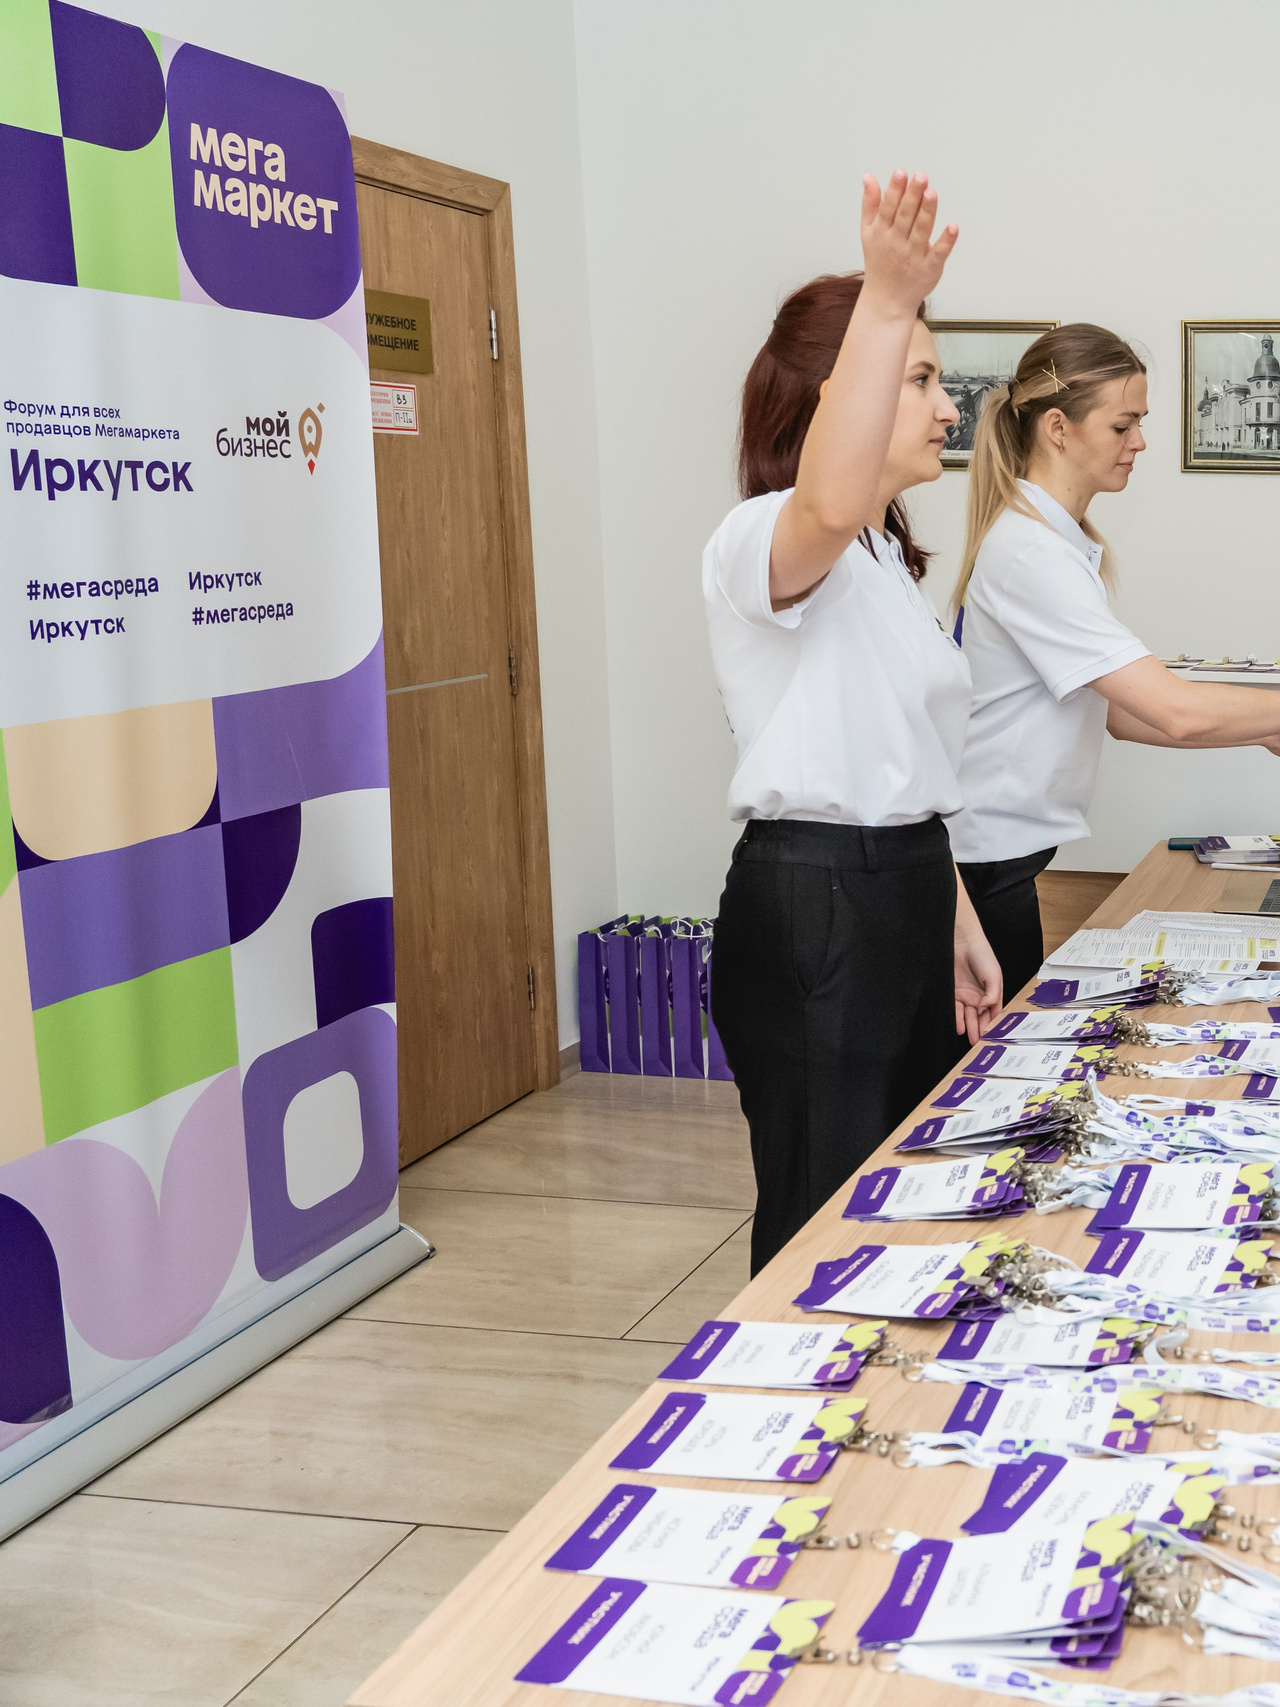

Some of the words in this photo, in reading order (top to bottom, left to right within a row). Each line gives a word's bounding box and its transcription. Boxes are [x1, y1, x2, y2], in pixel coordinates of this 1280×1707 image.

[190, 122, 286, 182] мега
[193, 169, 339, 234] маркет
[3, 399, 56, 418] Форум
[60, 404, 90, 418] для
[93, 406, 121, 419] всех
[6, 421, 92, 439] продавцов
[95, 424, 180, 441] Мегамаркета
[245, 411, 290, 437] мой
[216, 427, 292, 458] бизнес
[9, 448, 194, 501] Иркутск
[26, 577, 159, 600] #мегасреда
[188, 571, 262, 593] Иркутск
[29, 616, 126, 643] Иркутск
[192, 602, 294, 625] #мегасреда
[1119, 1172, 1138, 1204] УЧАСТНИК
[1196, 1172, 1212, 1197] среда
[1209, 1172, 1221, 1190] мега
[925, 1255, 948, 1275] мега
[1105, 1238, 1129, 1269] УЧАСТНИК
[1187, 1246, 1207, 1271] среда
[1201, 1247, 1217, 1265] мега
[831, 1254, 869, 1284] УЧАСТНИК
[648, 1407, 685, 1443] УЧАСТНИК
[772, 1413, 793, 1434] мега
[590, 1496, 633, 1539] УЧАСТНИК
[728, 1506, 752, 1530] мега
[901, 1554, 932, 1606] УЧАСТНИК
[569, 1592, 622, 1644] УЧАСТНИК
[719, 1609, 748, 1638] мега
